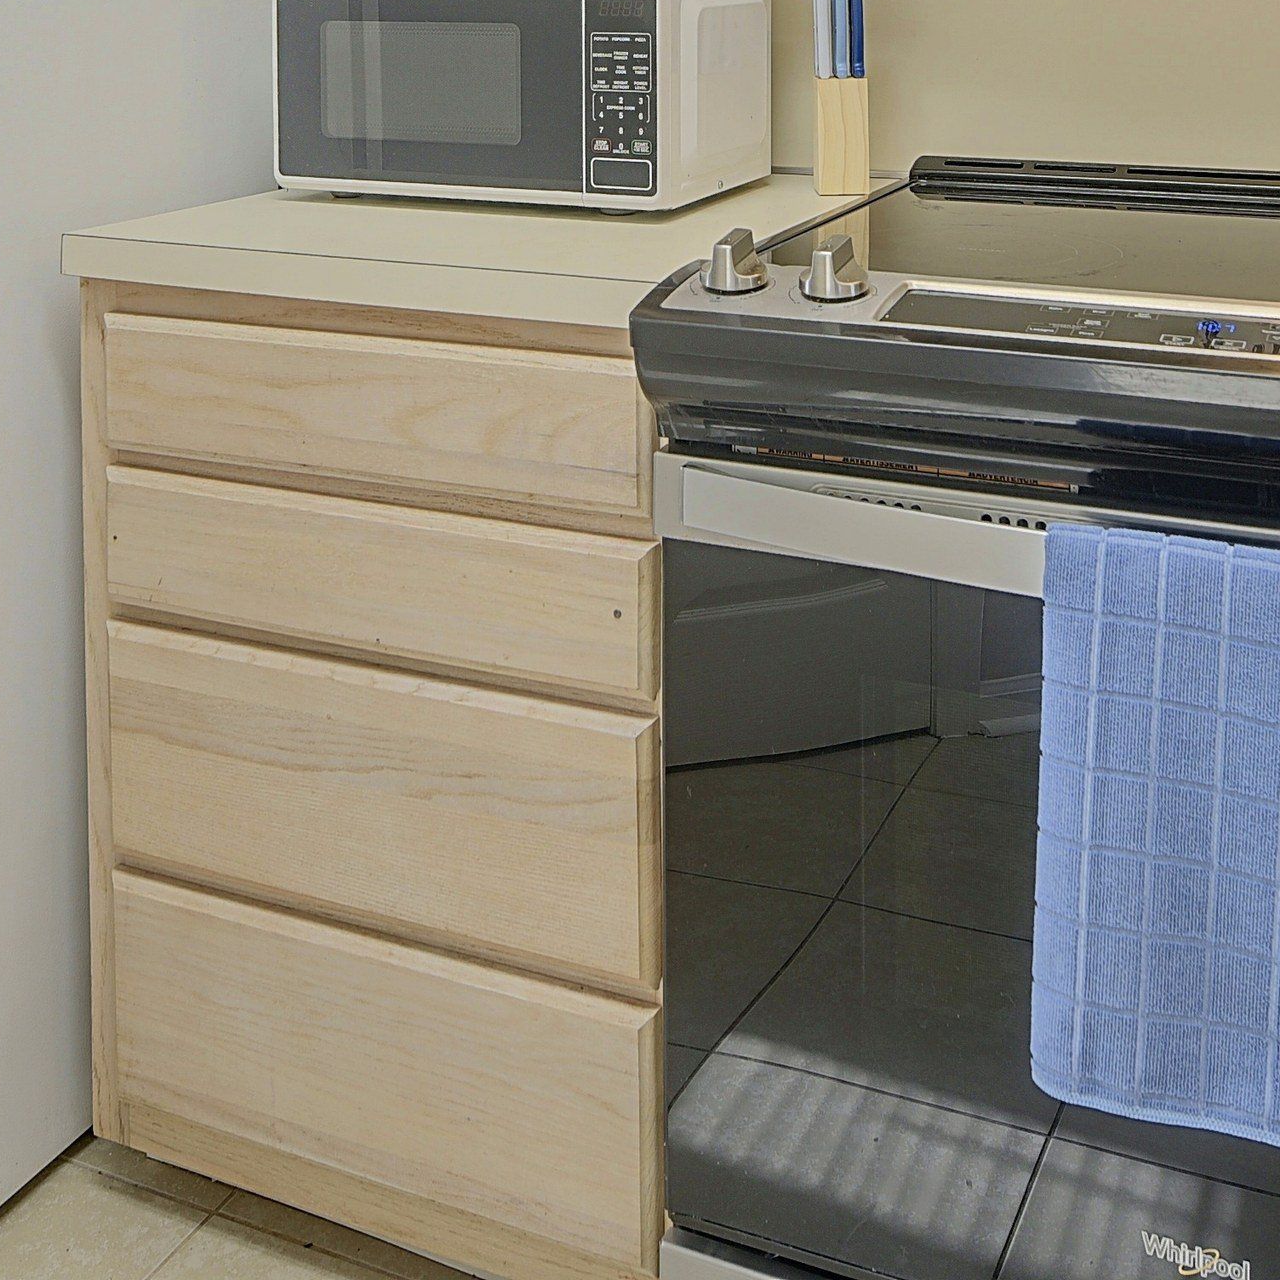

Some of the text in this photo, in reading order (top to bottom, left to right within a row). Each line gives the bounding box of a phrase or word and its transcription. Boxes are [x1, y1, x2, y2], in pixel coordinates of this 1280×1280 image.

[599, 96, 604, 104] 1
[618, 96, 624, 104] 2
[638, 97, 644, 105] 3
[598, 111, 604, 119] 4
[618, 111, 624, 119] 5
[638, 112, 644, 120] 6
[598, 126, 604, 134] 7
[618, 126, 624, 135] 8
[638, 127, 644, 136] 9
[1141, 1229, 1251, 1280] Whirlpool
